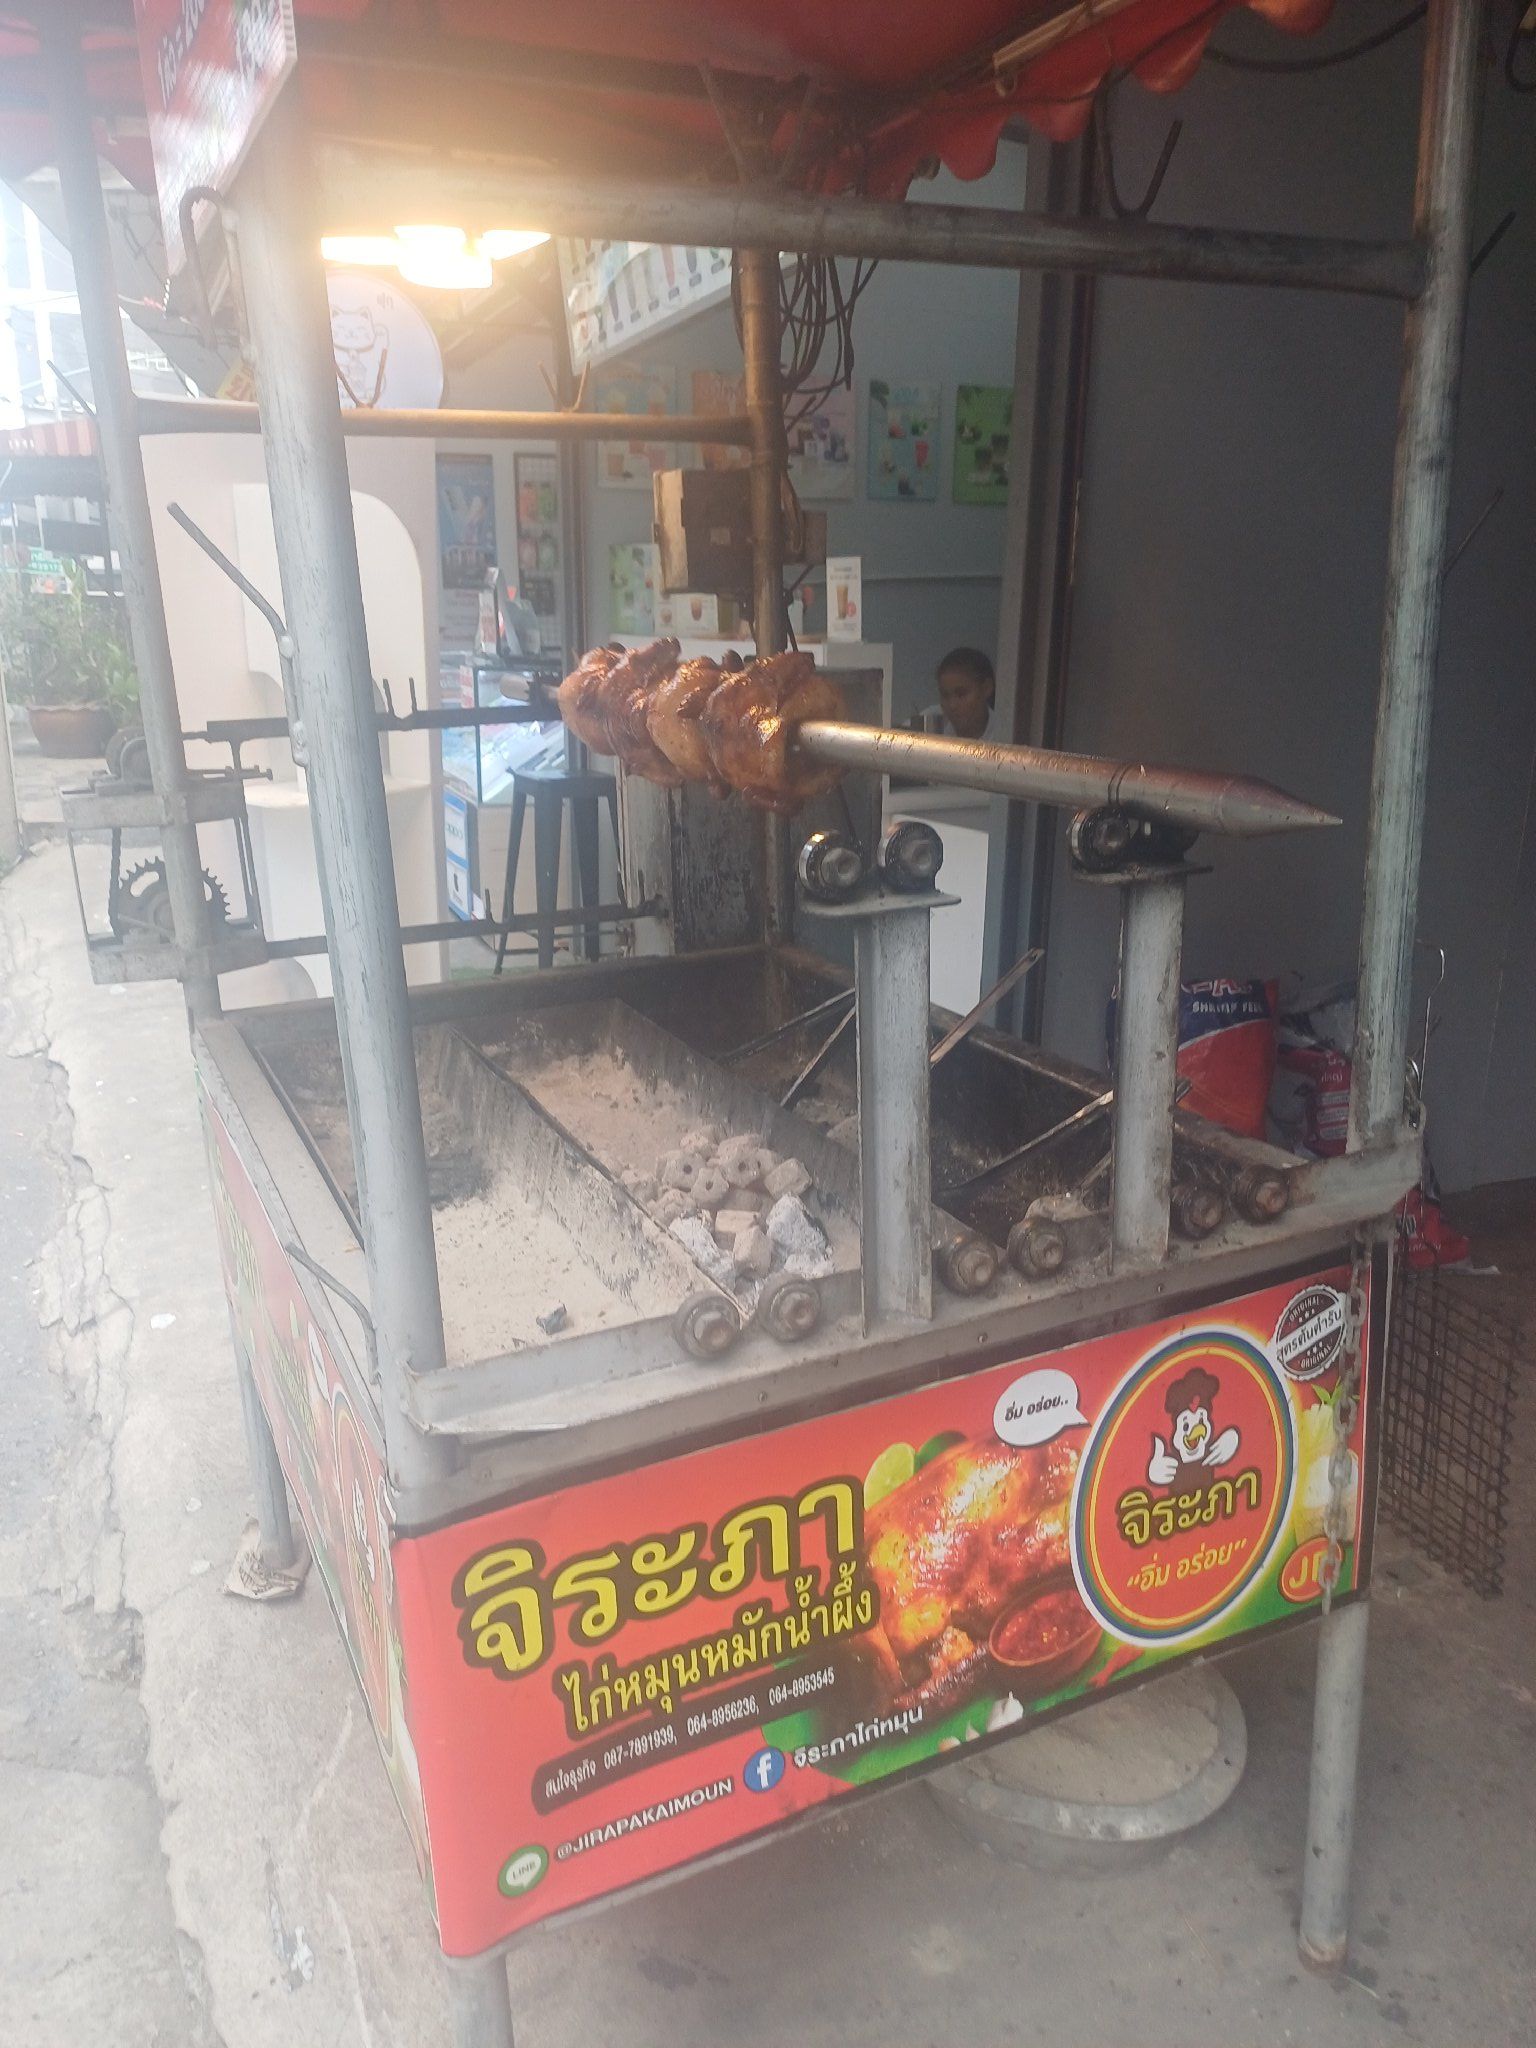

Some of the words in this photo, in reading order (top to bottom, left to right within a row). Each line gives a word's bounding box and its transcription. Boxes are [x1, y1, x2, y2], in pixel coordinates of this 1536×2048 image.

[1120, 1471, 1257, 1544] จิระภา
[463, 1482, 855, 1673] จิระภา
[562, 1561, 872, 1732] ไก่หมุนหมักน้ำผึ้ง
[557, 1778, 734, 1860] @JIRAPAKAIMOUN
[512, 1861, 536, 1880] LINE
